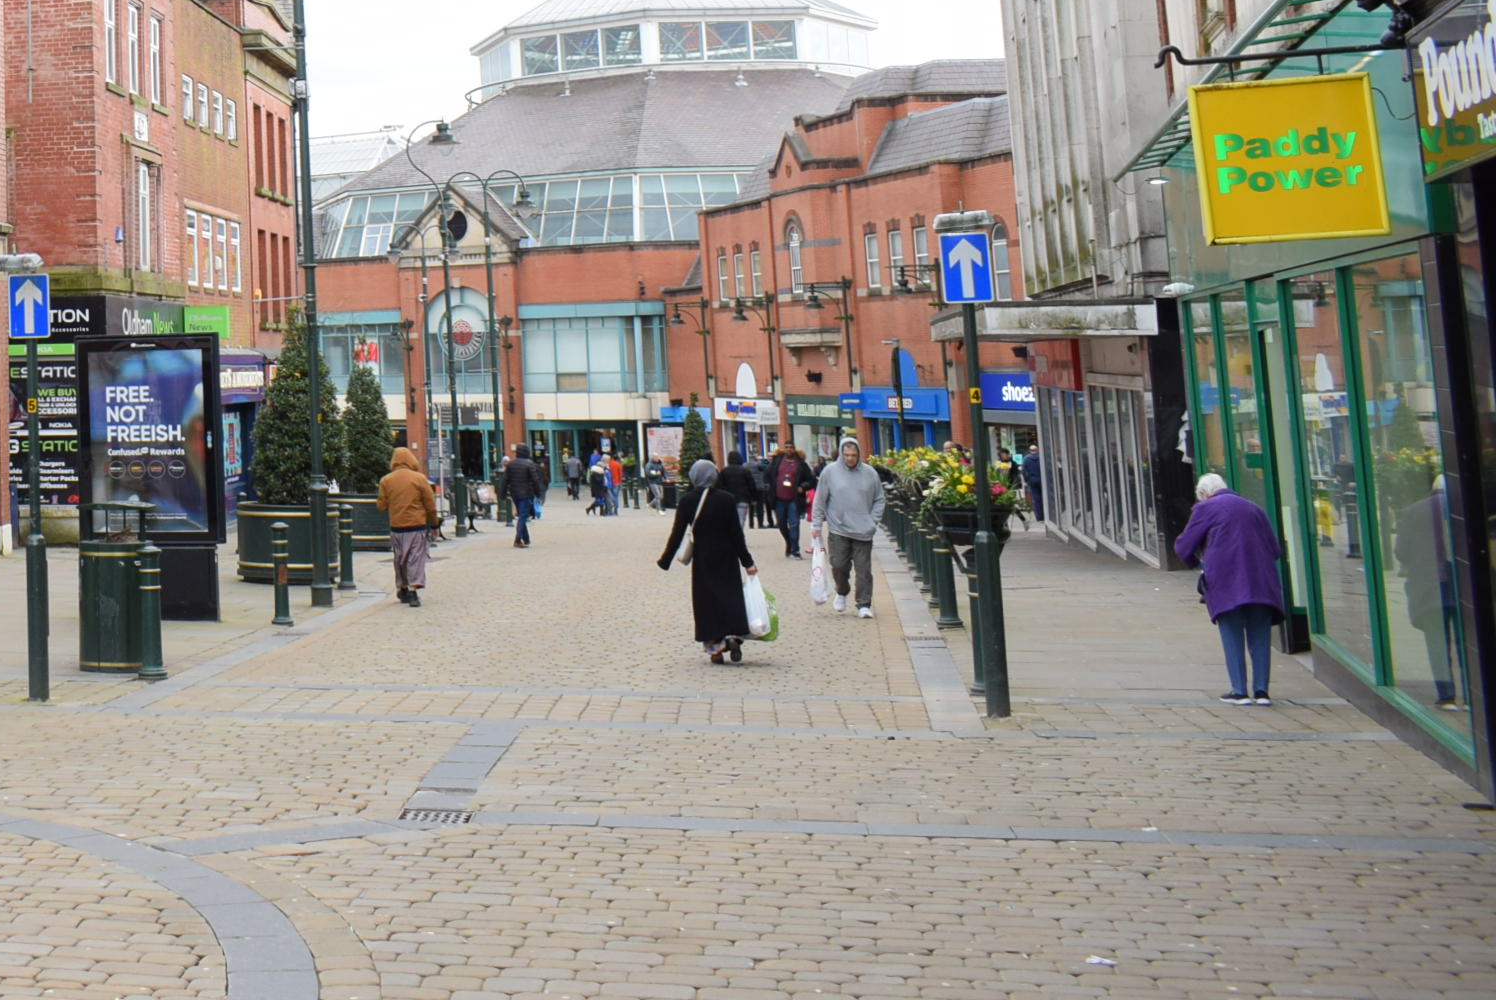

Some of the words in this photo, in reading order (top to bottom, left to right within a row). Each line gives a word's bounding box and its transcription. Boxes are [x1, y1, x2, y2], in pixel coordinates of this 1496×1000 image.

[1214, 127, 1358, 161] Paddy
[1217, 164, 1363, 194] Power
[50, 309, 90, 323] TION
[122, 307, 153, 335] Oldham
[189, 323, 212, 331] News
[105, 386, 154, 403] FREE.
[971, 390, 980, 401] 4
[1001, 381, 1035, 402] shoez
[28, 400, 36, 411] 5
[106, 405, 147, 423] NOT
[107, 424, 186, 443] FREEISH.
[150, 447, 185, 456] Rewards
